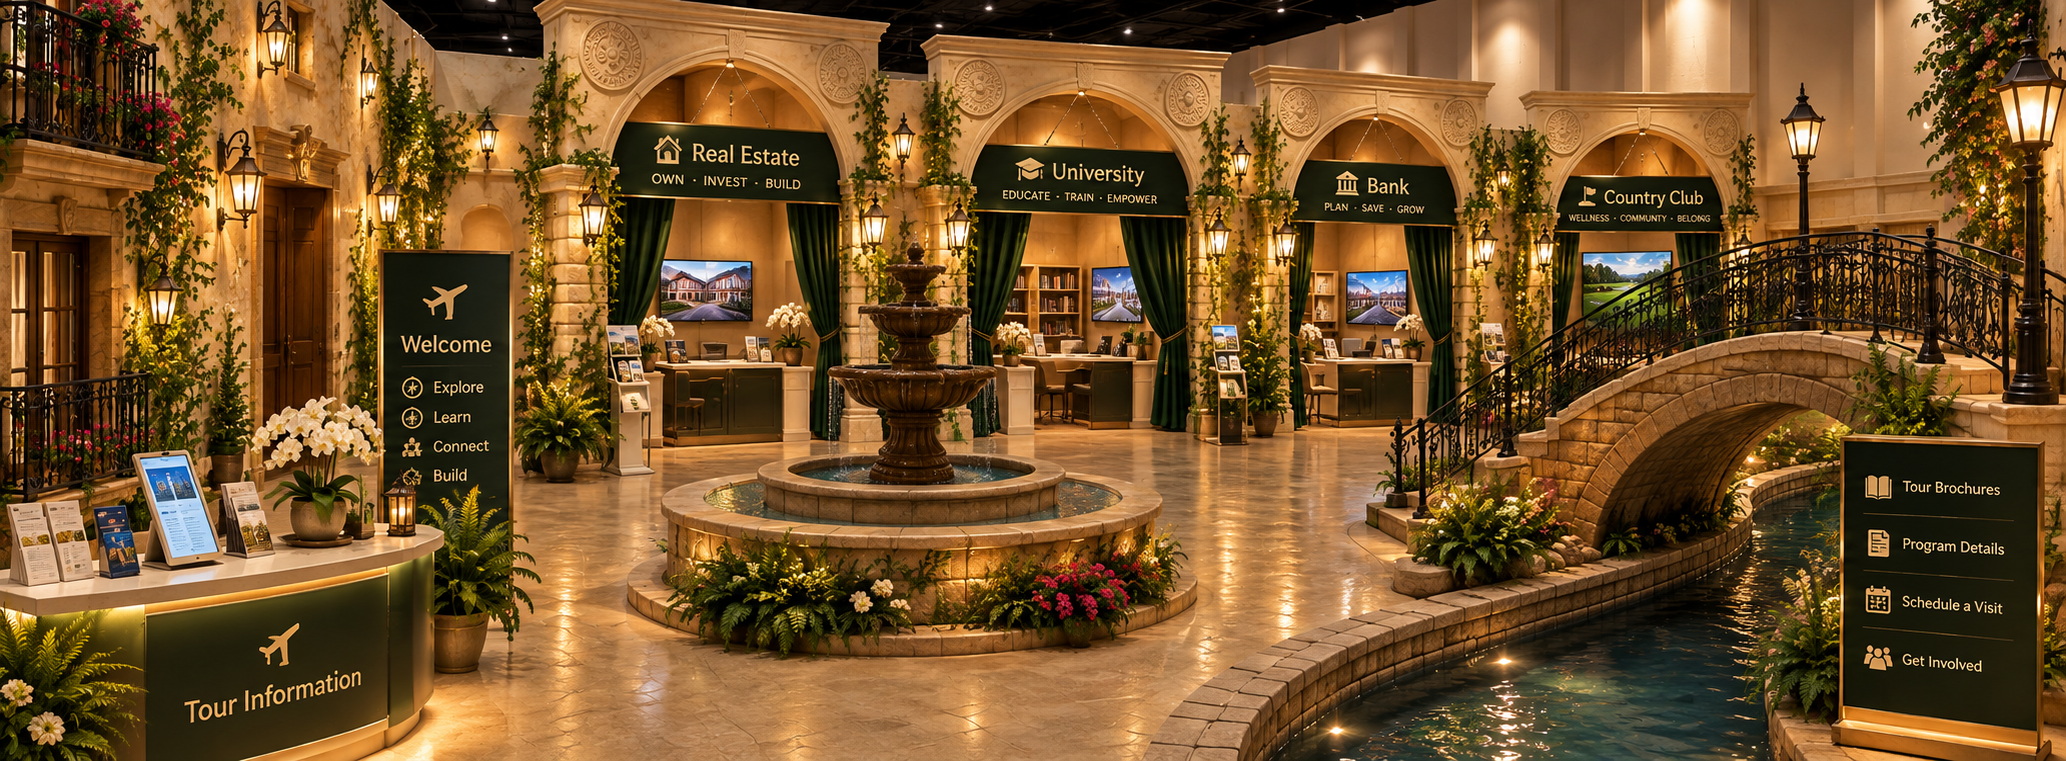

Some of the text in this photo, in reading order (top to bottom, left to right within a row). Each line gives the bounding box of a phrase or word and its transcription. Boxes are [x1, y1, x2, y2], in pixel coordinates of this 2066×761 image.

[692, 142, 800, 167] Real Estate
[651, 172, 801, 190] OWN INVEST BUILD
[1052, 162, 1145, 188] University
[1367, 177, 1410, 195] Bank
[1002, 189, 1158, 205] EDUCATE TRAIN EMPOWER
[1604, 189, 1704, 209] Country Club
[1324, 202, 1425, 214] PLAN SAVE GROW
[1568, 213, 1610, 223] WELLNESS
[400, 334, 492, 354] Welcome
[433, 380, 484, 397] Explore
[433, 410, 471, 424] Learn
[433, 439, 490, 453] Connect
[433, 468, 468, 483] Build
[1902, 480, 2001, 497] Tour Brochures
[1902, 537, 2006, 556] Program Details
[1902, 595, 2003, 615] Schedule a Visit
[1902, 653, 1983, 673] Get Involved
[184, 669, 362, 724] Tour Information
